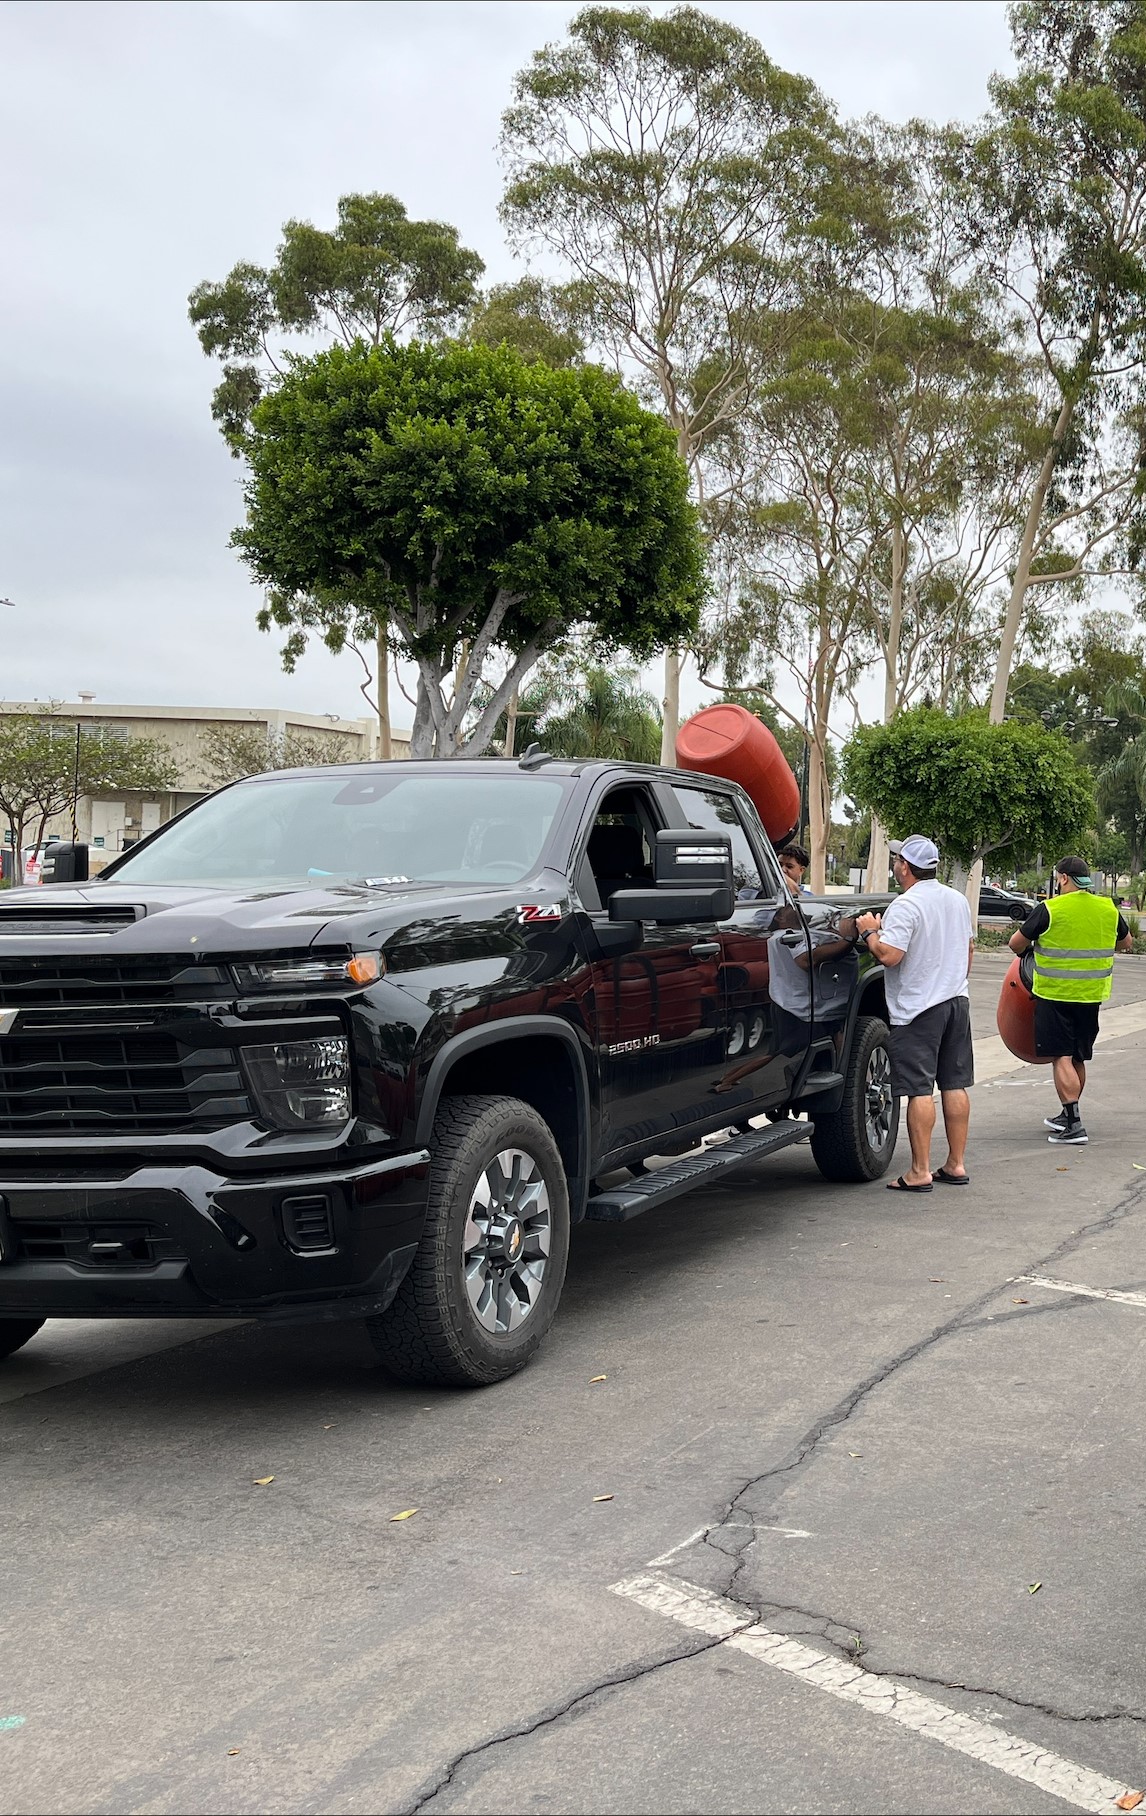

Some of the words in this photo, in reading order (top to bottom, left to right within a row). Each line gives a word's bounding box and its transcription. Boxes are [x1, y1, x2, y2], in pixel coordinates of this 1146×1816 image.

[516, 904, 562, 923] Z71
[609, 1039, 641, 1056] 2500
[643, 1034, 661, 1048] HD
